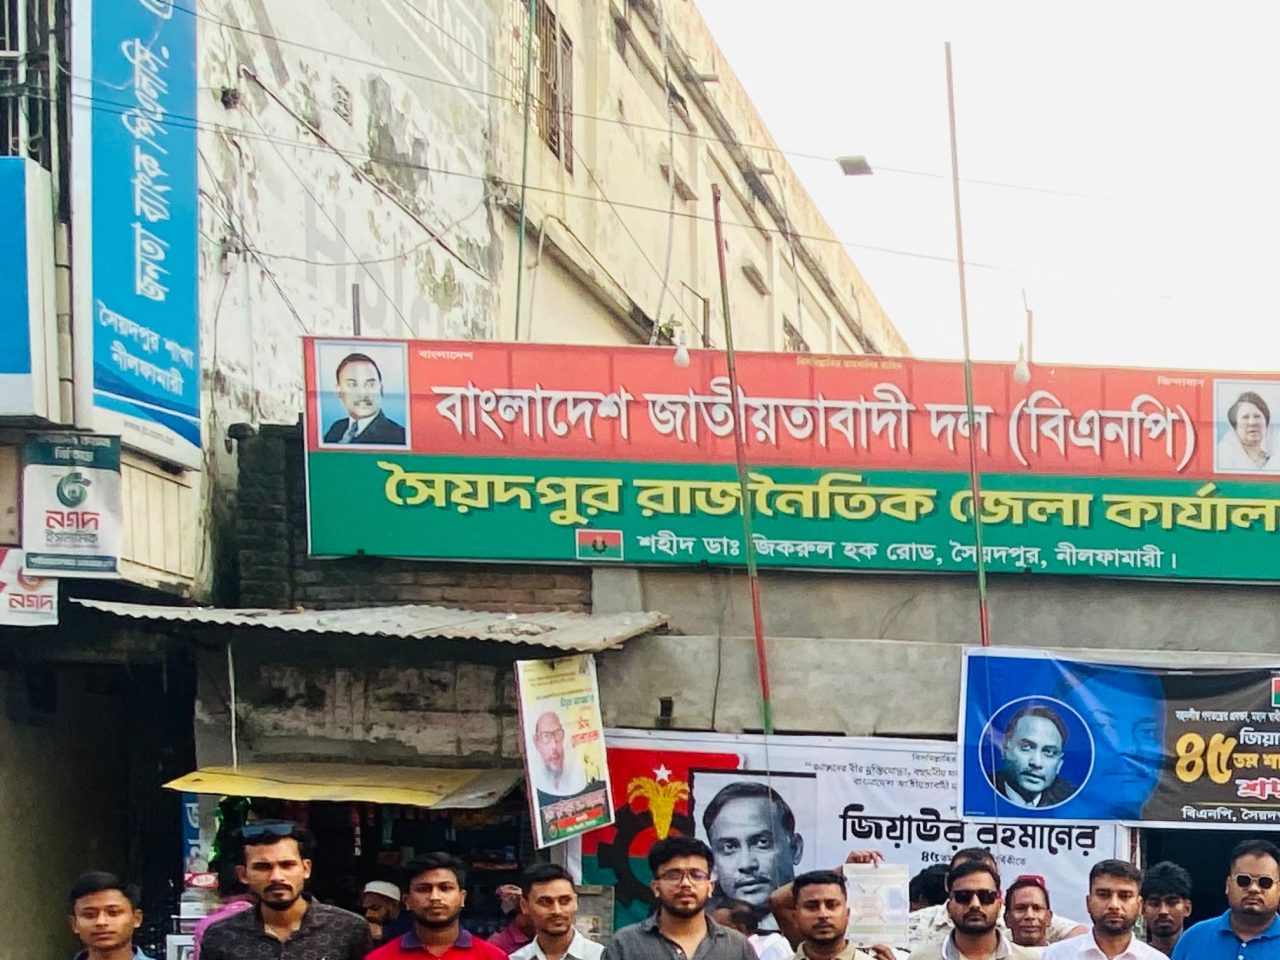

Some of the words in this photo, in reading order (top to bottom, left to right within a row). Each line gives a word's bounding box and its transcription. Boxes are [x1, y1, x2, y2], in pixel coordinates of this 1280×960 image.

[131, 145, 171, 222] ব্যাংক
[131, 221, 170, 301] জনতা
[162, 338, 195, 369] শাখা
[430, 380, 633, 440] বাংলাদেশ
[642, 377, 917, 449] জাতীয়তাবাদী
[924, 402, 994, 451] দল
[1009, 391, 1195, 472] (বিএনপি)
[377, 461, 622, 526] সৈয়দপুর
[633, 472, 936, 521] রাজনৈতিক
[950, 488, 1093, 527] জেলা
[46, 511, 100, 530] নগদ
[637, 530, 696, 556] শহীদ
[702, 536, 740, 556] ডাঃ
[750, 533, 833, 558] জিকরুল
[841, 541, 878, 561] হক
[887, 543, 943, 565] রোড,
[949, 539, 1047, 568] সৈয়দপুর,
[8, 593, 53, 610] নগদ
[1175, 732, 1237, 784] ৪৫
[1233, 753, 1259, 768] তম
[839, 803, 965, 851] জিয়াউর
[976, 822, 1099, 857] রহমানের
[1182, 806, 1237, 821] বিএনপি,
